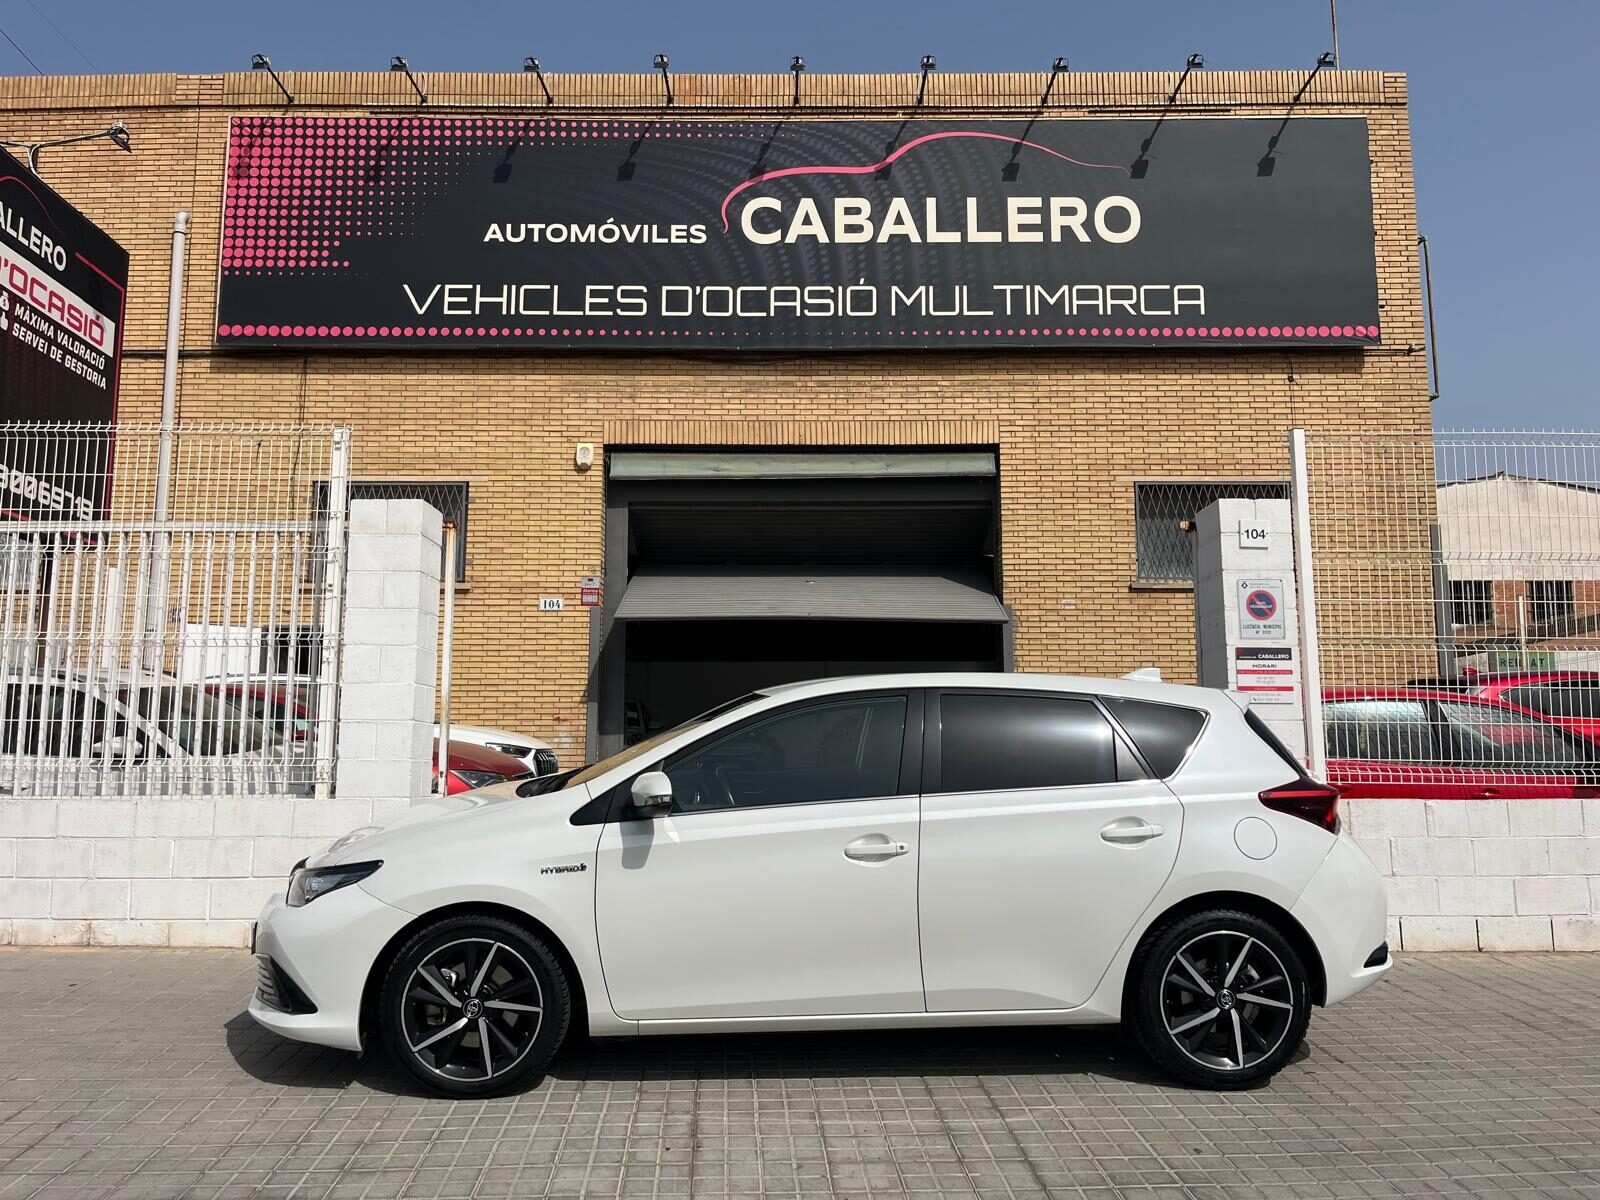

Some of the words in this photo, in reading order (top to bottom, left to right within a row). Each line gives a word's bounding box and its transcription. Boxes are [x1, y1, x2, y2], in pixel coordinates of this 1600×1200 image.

[483, 217, 708, 244] AUTOMÓVILES
[741, 195, 1142, 244] CABALLERO
[403, 284, 648, 316] VEHICLES
[661, 278, 877, 318] D'OCASIÓ
[892, 284, 1206, 316] MULTIMARCA
[12, 323, 48, 355] SERVEI
[50, 345, 62, 363] DE
[64, 354, 107, 390] GESTORIA
[14, 303, 54, 339] MÀXIMA
[57, 329, 105, 371] VALORACIÓ
[1244, 528, 1266, 540] 104
[543, 599, 561, 609] 104
